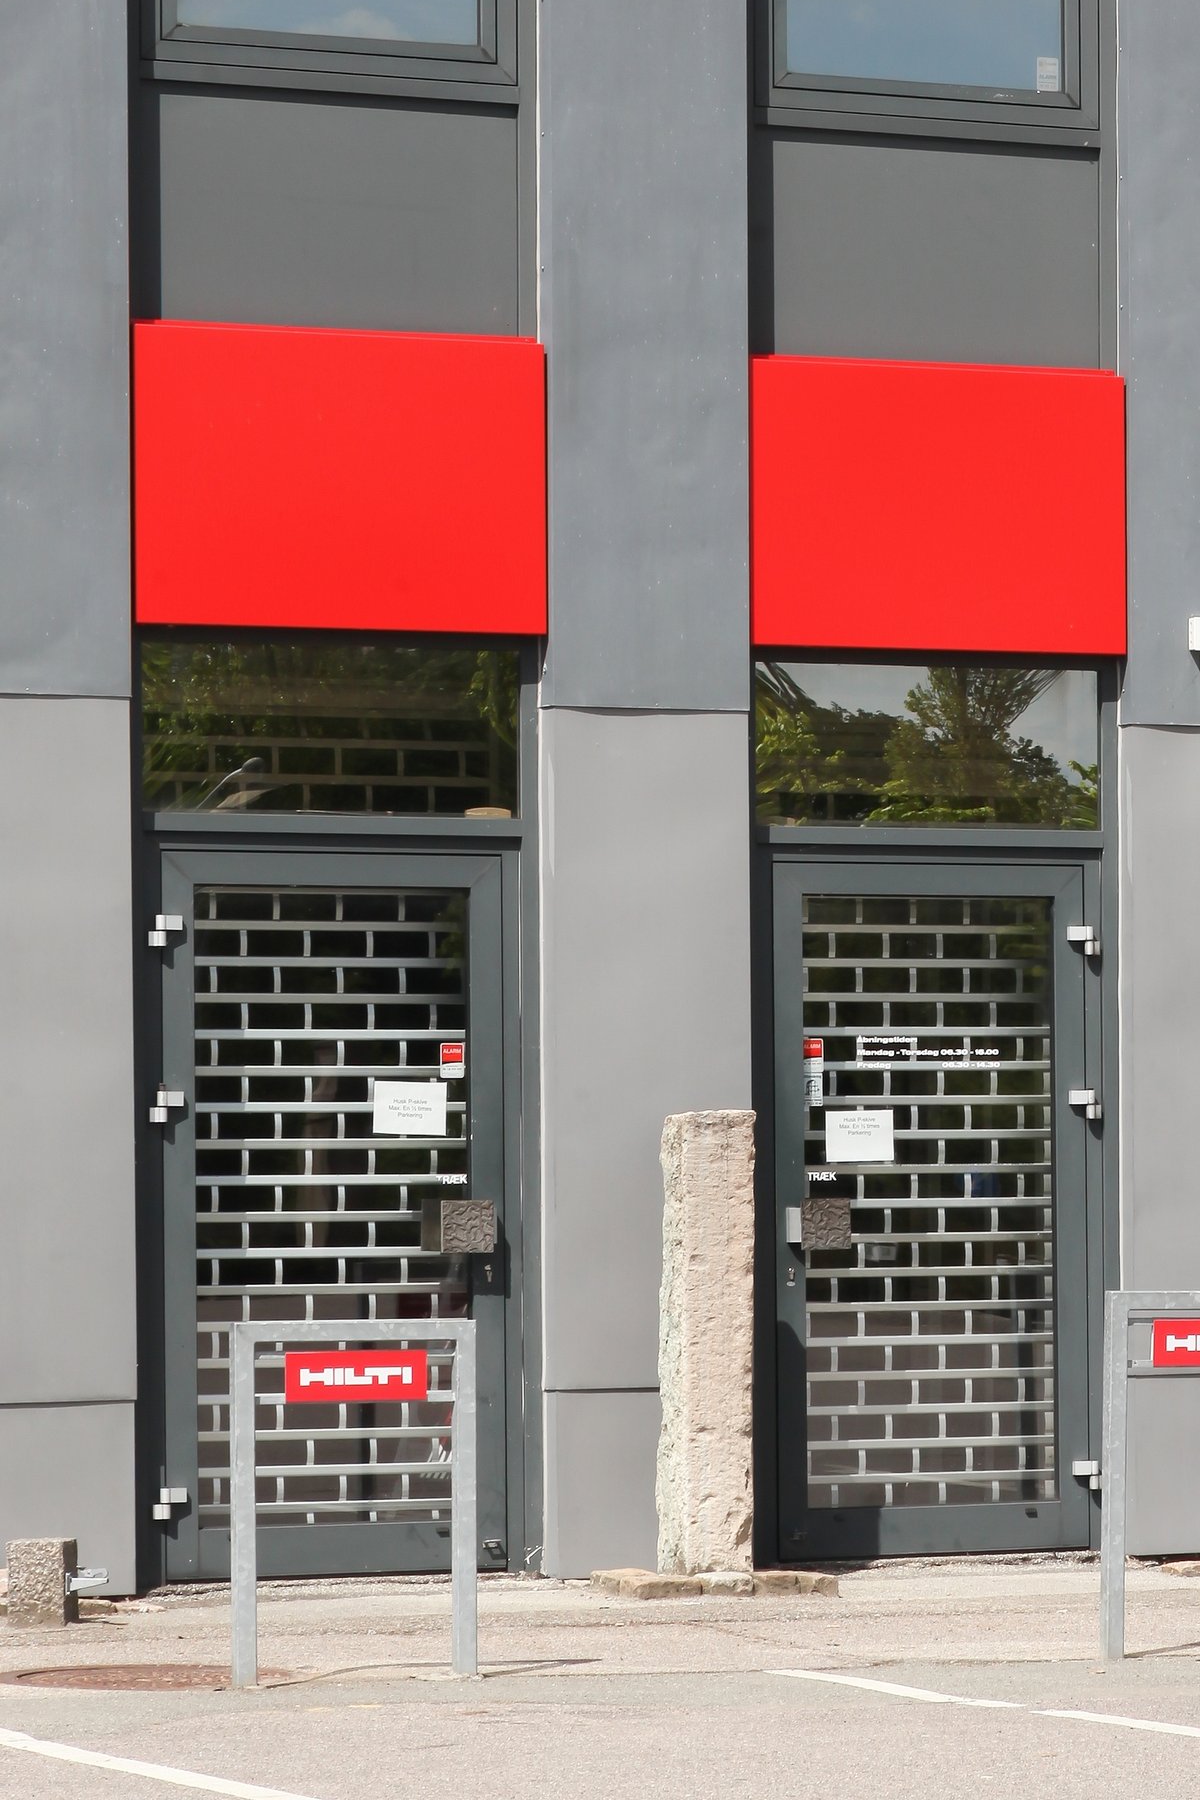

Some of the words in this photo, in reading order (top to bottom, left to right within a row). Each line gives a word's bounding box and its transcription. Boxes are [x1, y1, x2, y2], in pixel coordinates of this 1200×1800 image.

[856, 1048, 895, 1057] Mandag
[900, 1048, 939, 1057] Torsdag
[857, 1061, 892, 1069] Fredag
[807, 1171, 837, 1182] TRÆK
[299, 1366, 413, 1387] HILTI
